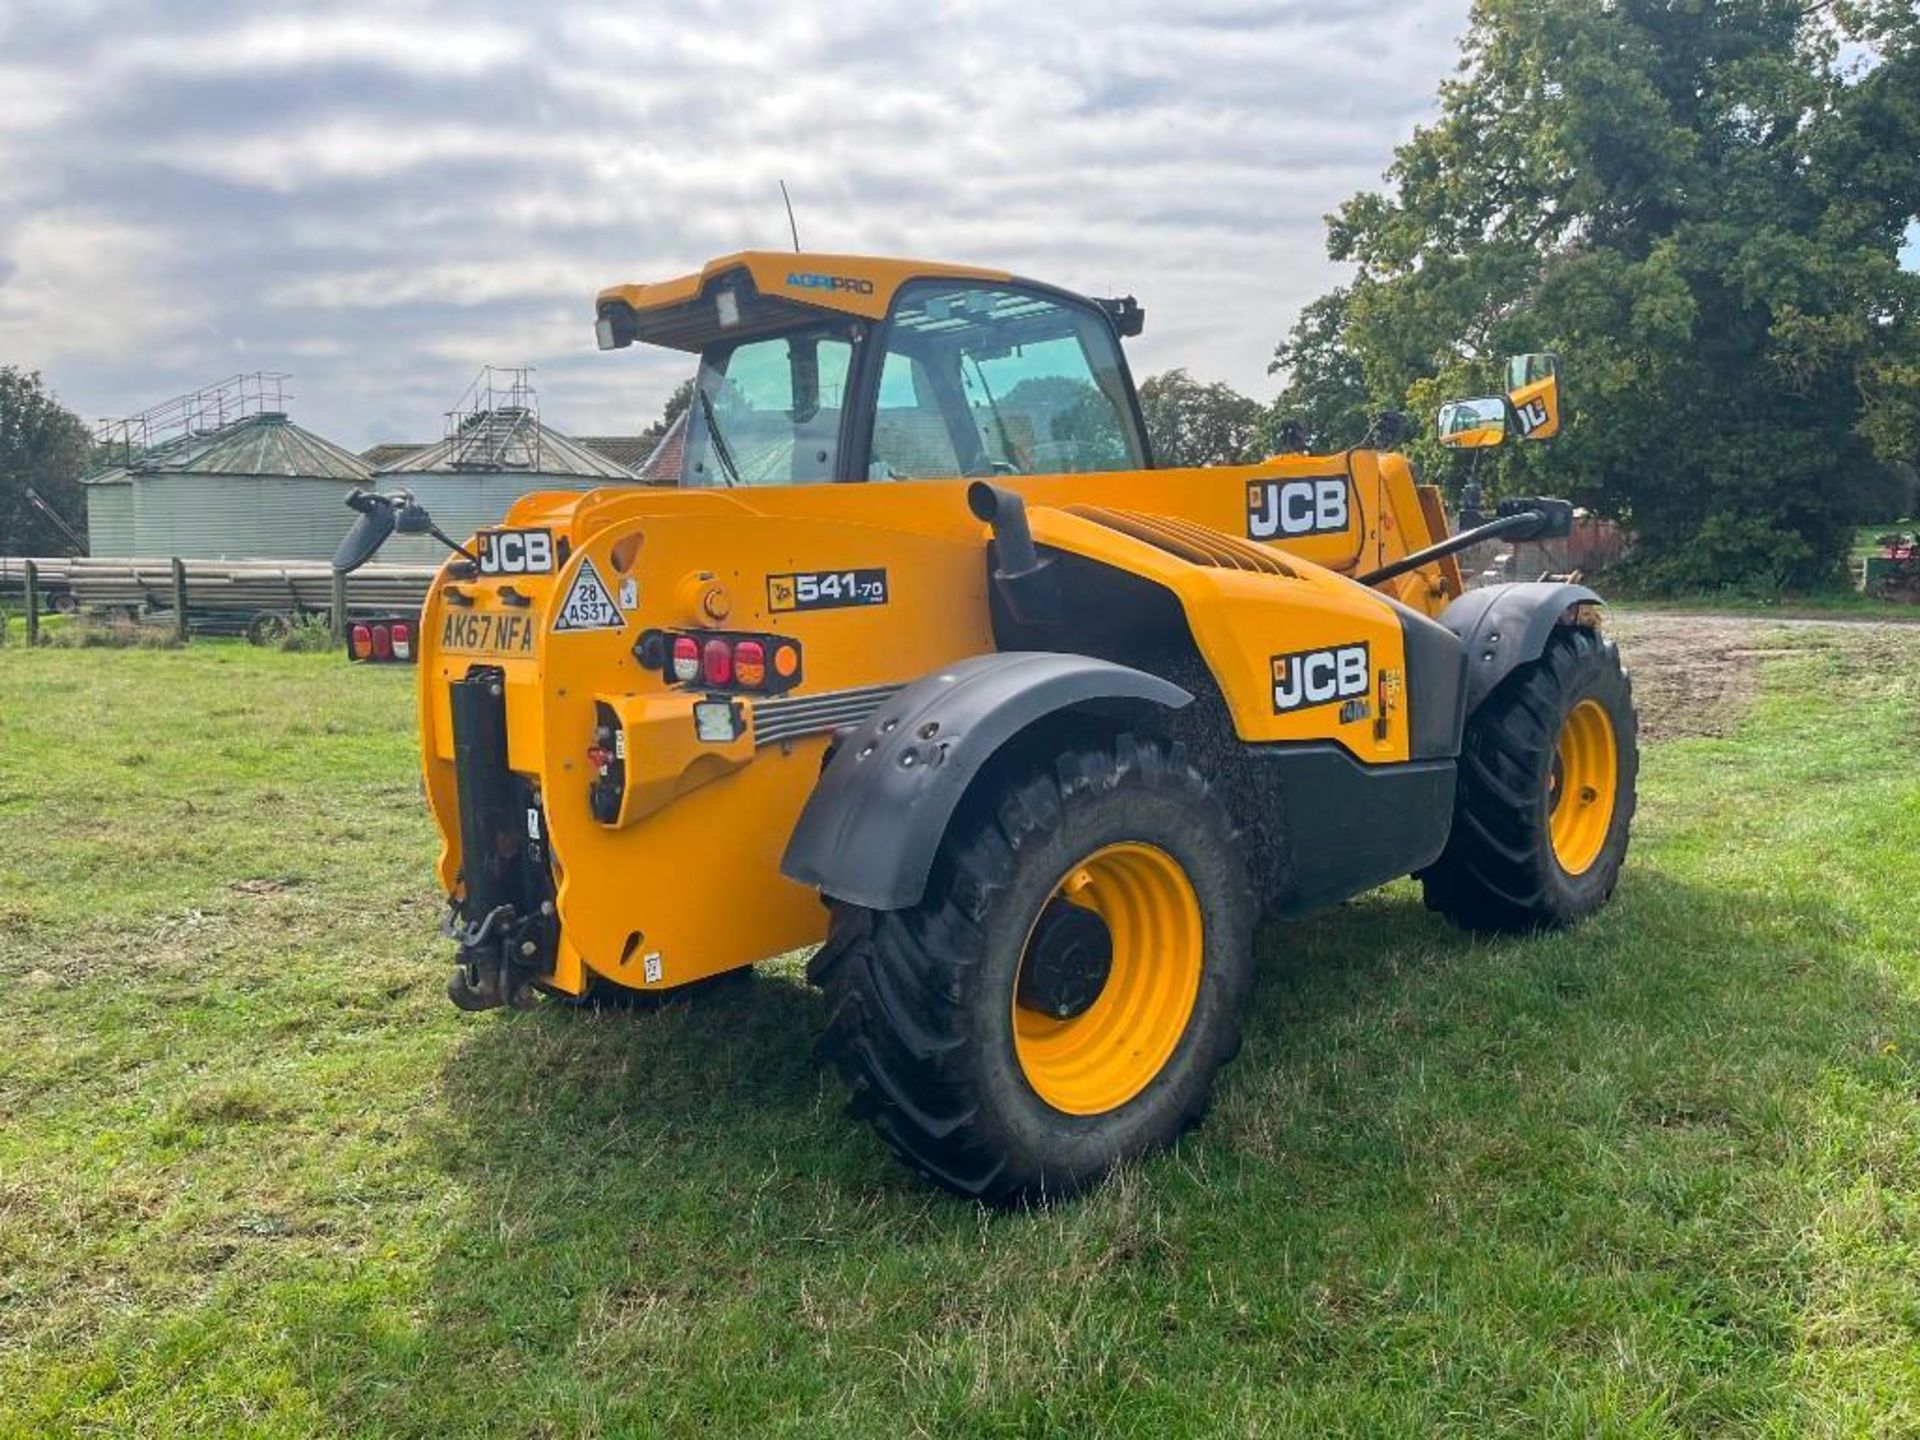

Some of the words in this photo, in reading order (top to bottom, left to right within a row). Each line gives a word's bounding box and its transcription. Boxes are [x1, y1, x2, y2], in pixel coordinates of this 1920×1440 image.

[1250, 480, 1347, 536] JCB
[480, 533, 552, 572] JCB
[579, 585, 598, 602] 28
[797, 573, 883, 600] 541-70
[569, 602, 608, 622] AS3T
[442, 614, 491, 648] AK67
[494, 616, 531, 651] NFA
[1275, 647, 1368, 708] JCB
